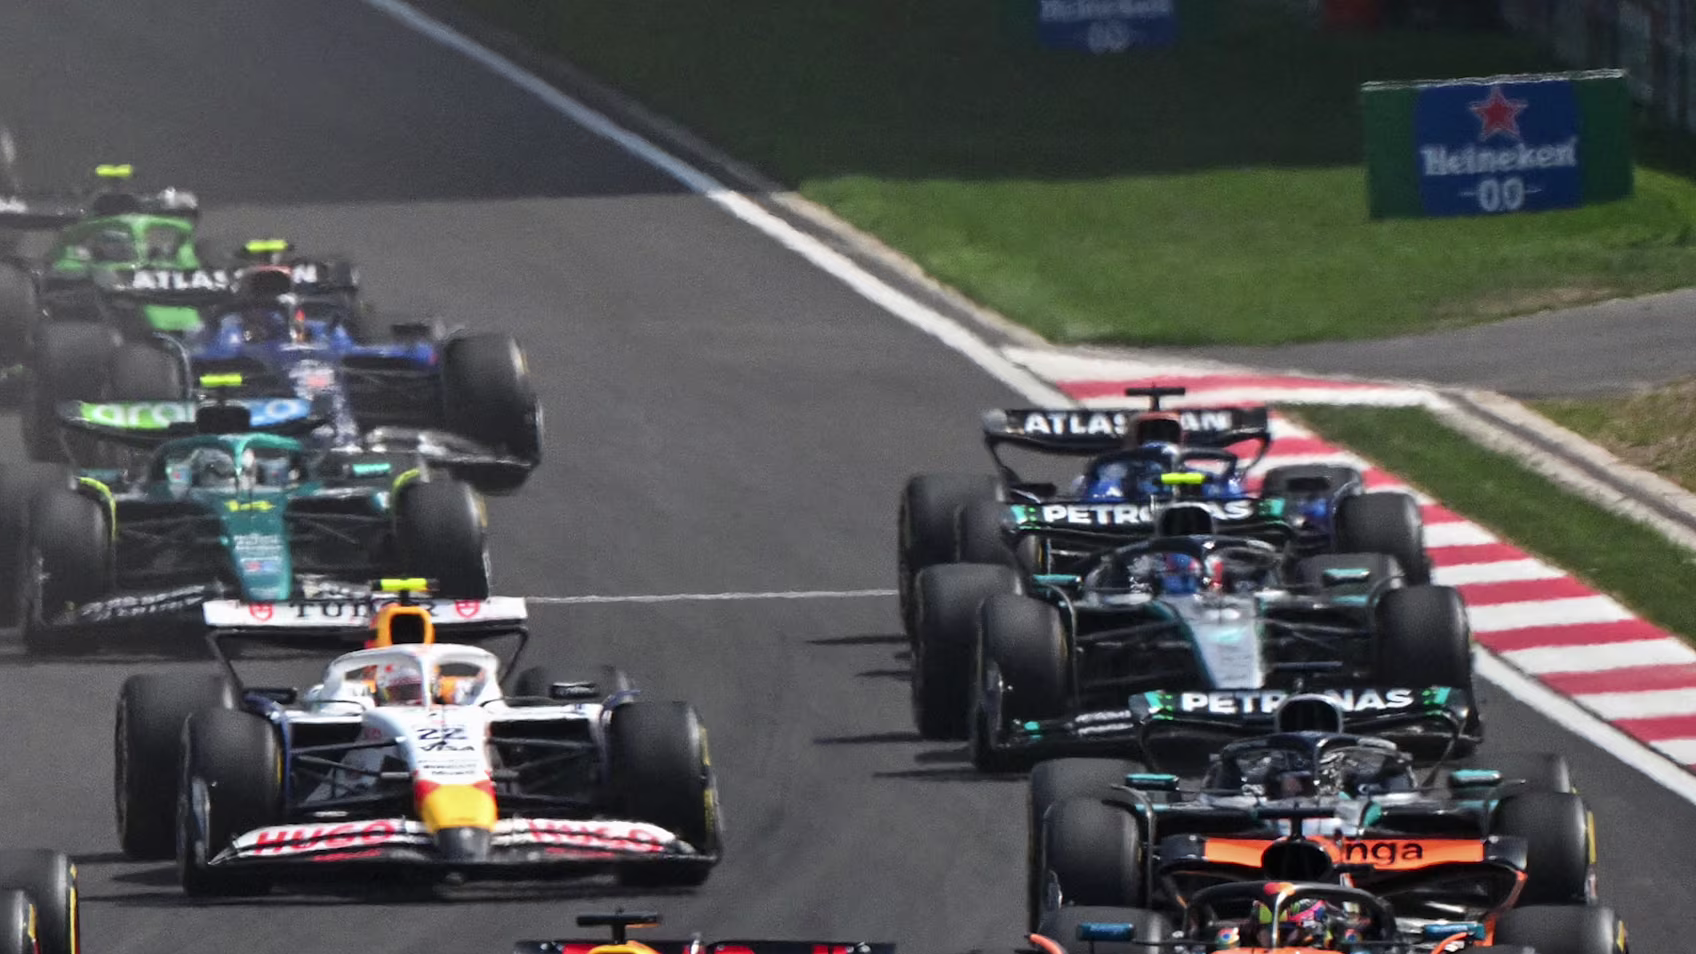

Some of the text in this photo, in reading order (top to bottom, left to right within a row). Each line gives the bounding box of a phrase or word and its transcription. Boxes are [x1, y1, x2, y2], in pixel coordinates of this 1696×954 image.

[1421, 136, 1576, 175] Heineken
[1024, 412, 1232, 434] ATLASAN
[1180, 688, 1413, 714] PETRNAS
[417, 728, 468, 740] 22
[255, 820, 397, 855] HUGO
